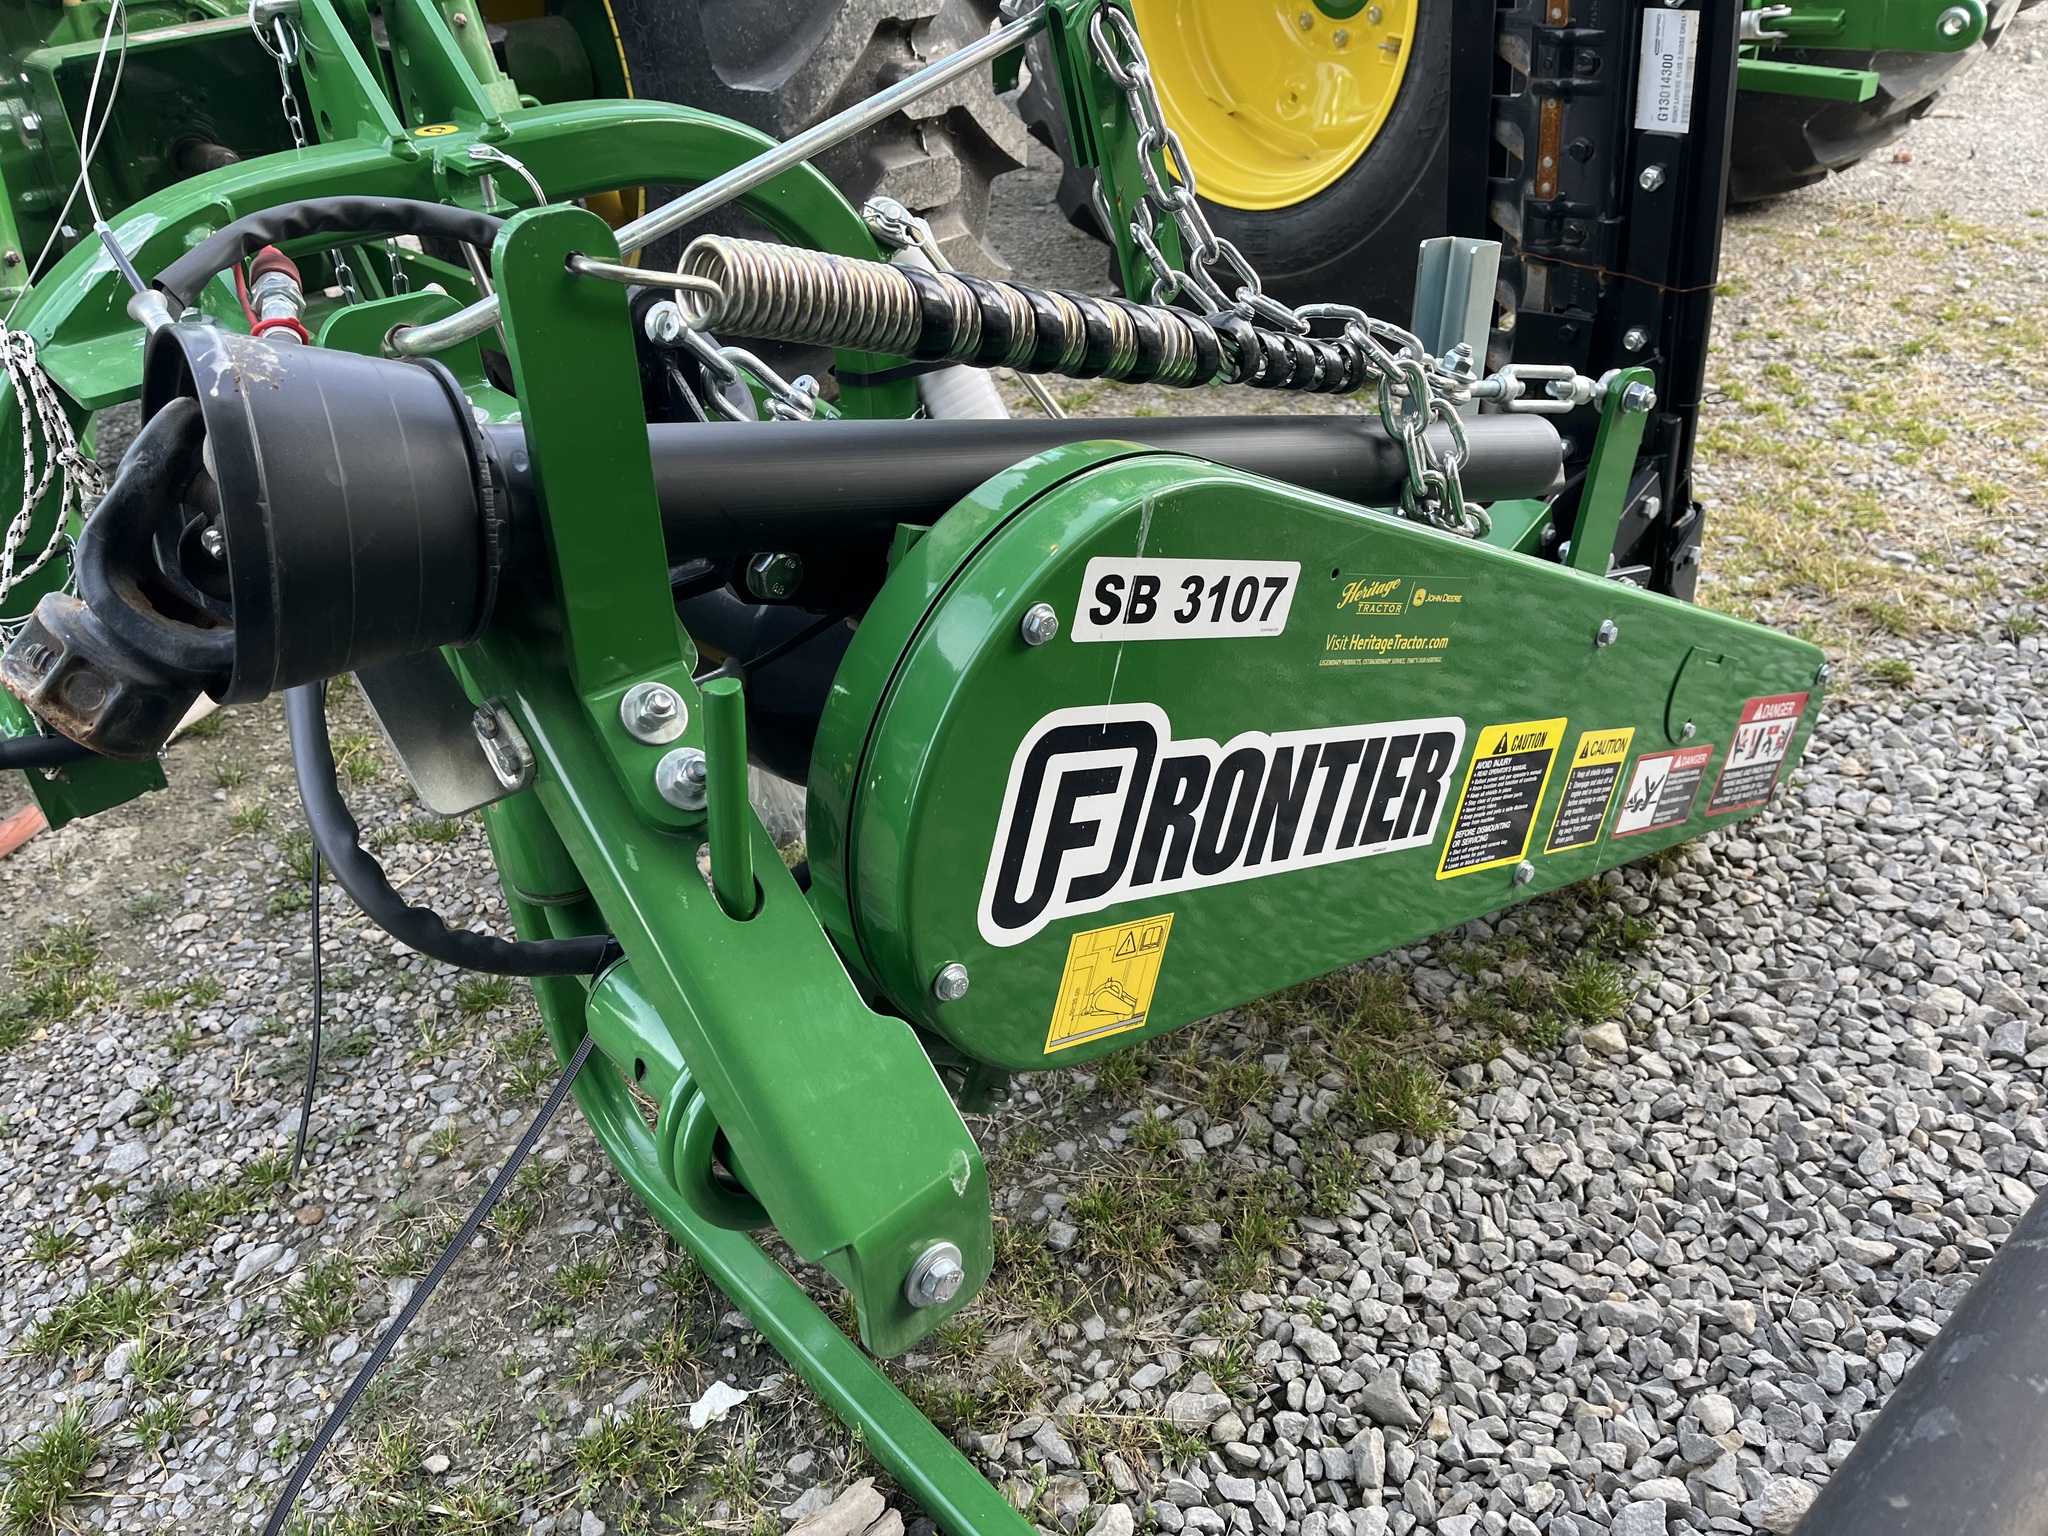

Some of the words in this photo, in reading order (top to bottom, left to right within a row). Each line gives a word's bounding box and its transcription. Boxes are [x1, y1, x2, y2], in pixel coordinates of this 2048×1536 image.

[1657, 54, 1674, 121] G13014300
[1089, 574, 1161, 626] SB
[1174, 575, 1290, 624] 3107
[1336, 578, 1400, 609] Heritage
[1425, 593, 1442, 602] JOHN
[1442, 594, 1462, 602] DEERE
[1358, 604, 1402, 612] TRACTOR
[1326, 634, 1348, 650] Visit
[1349, 634, 1449, 654] HeritageTractor.com
[1762, 702, 1796, 718] DANGER
[1510, 732, 1548, 752] CAUTION
[1590, 738, 1628, 756] CAUTION
[1476, 760, 1492, 770] AVOID
[1493, 757, 1512, 768] INJURY
[1681, 753, 1707, 767] DANGER
[991, 720, 1457, 930] FRONTIER
[1455, 827, 1476, 838] BEFORE
[1476, 821, 1511, 834] DISMOUNTING
[1452, 840, 1461, 848] OR
[1461, 834, 1489, 846] SERVICING
